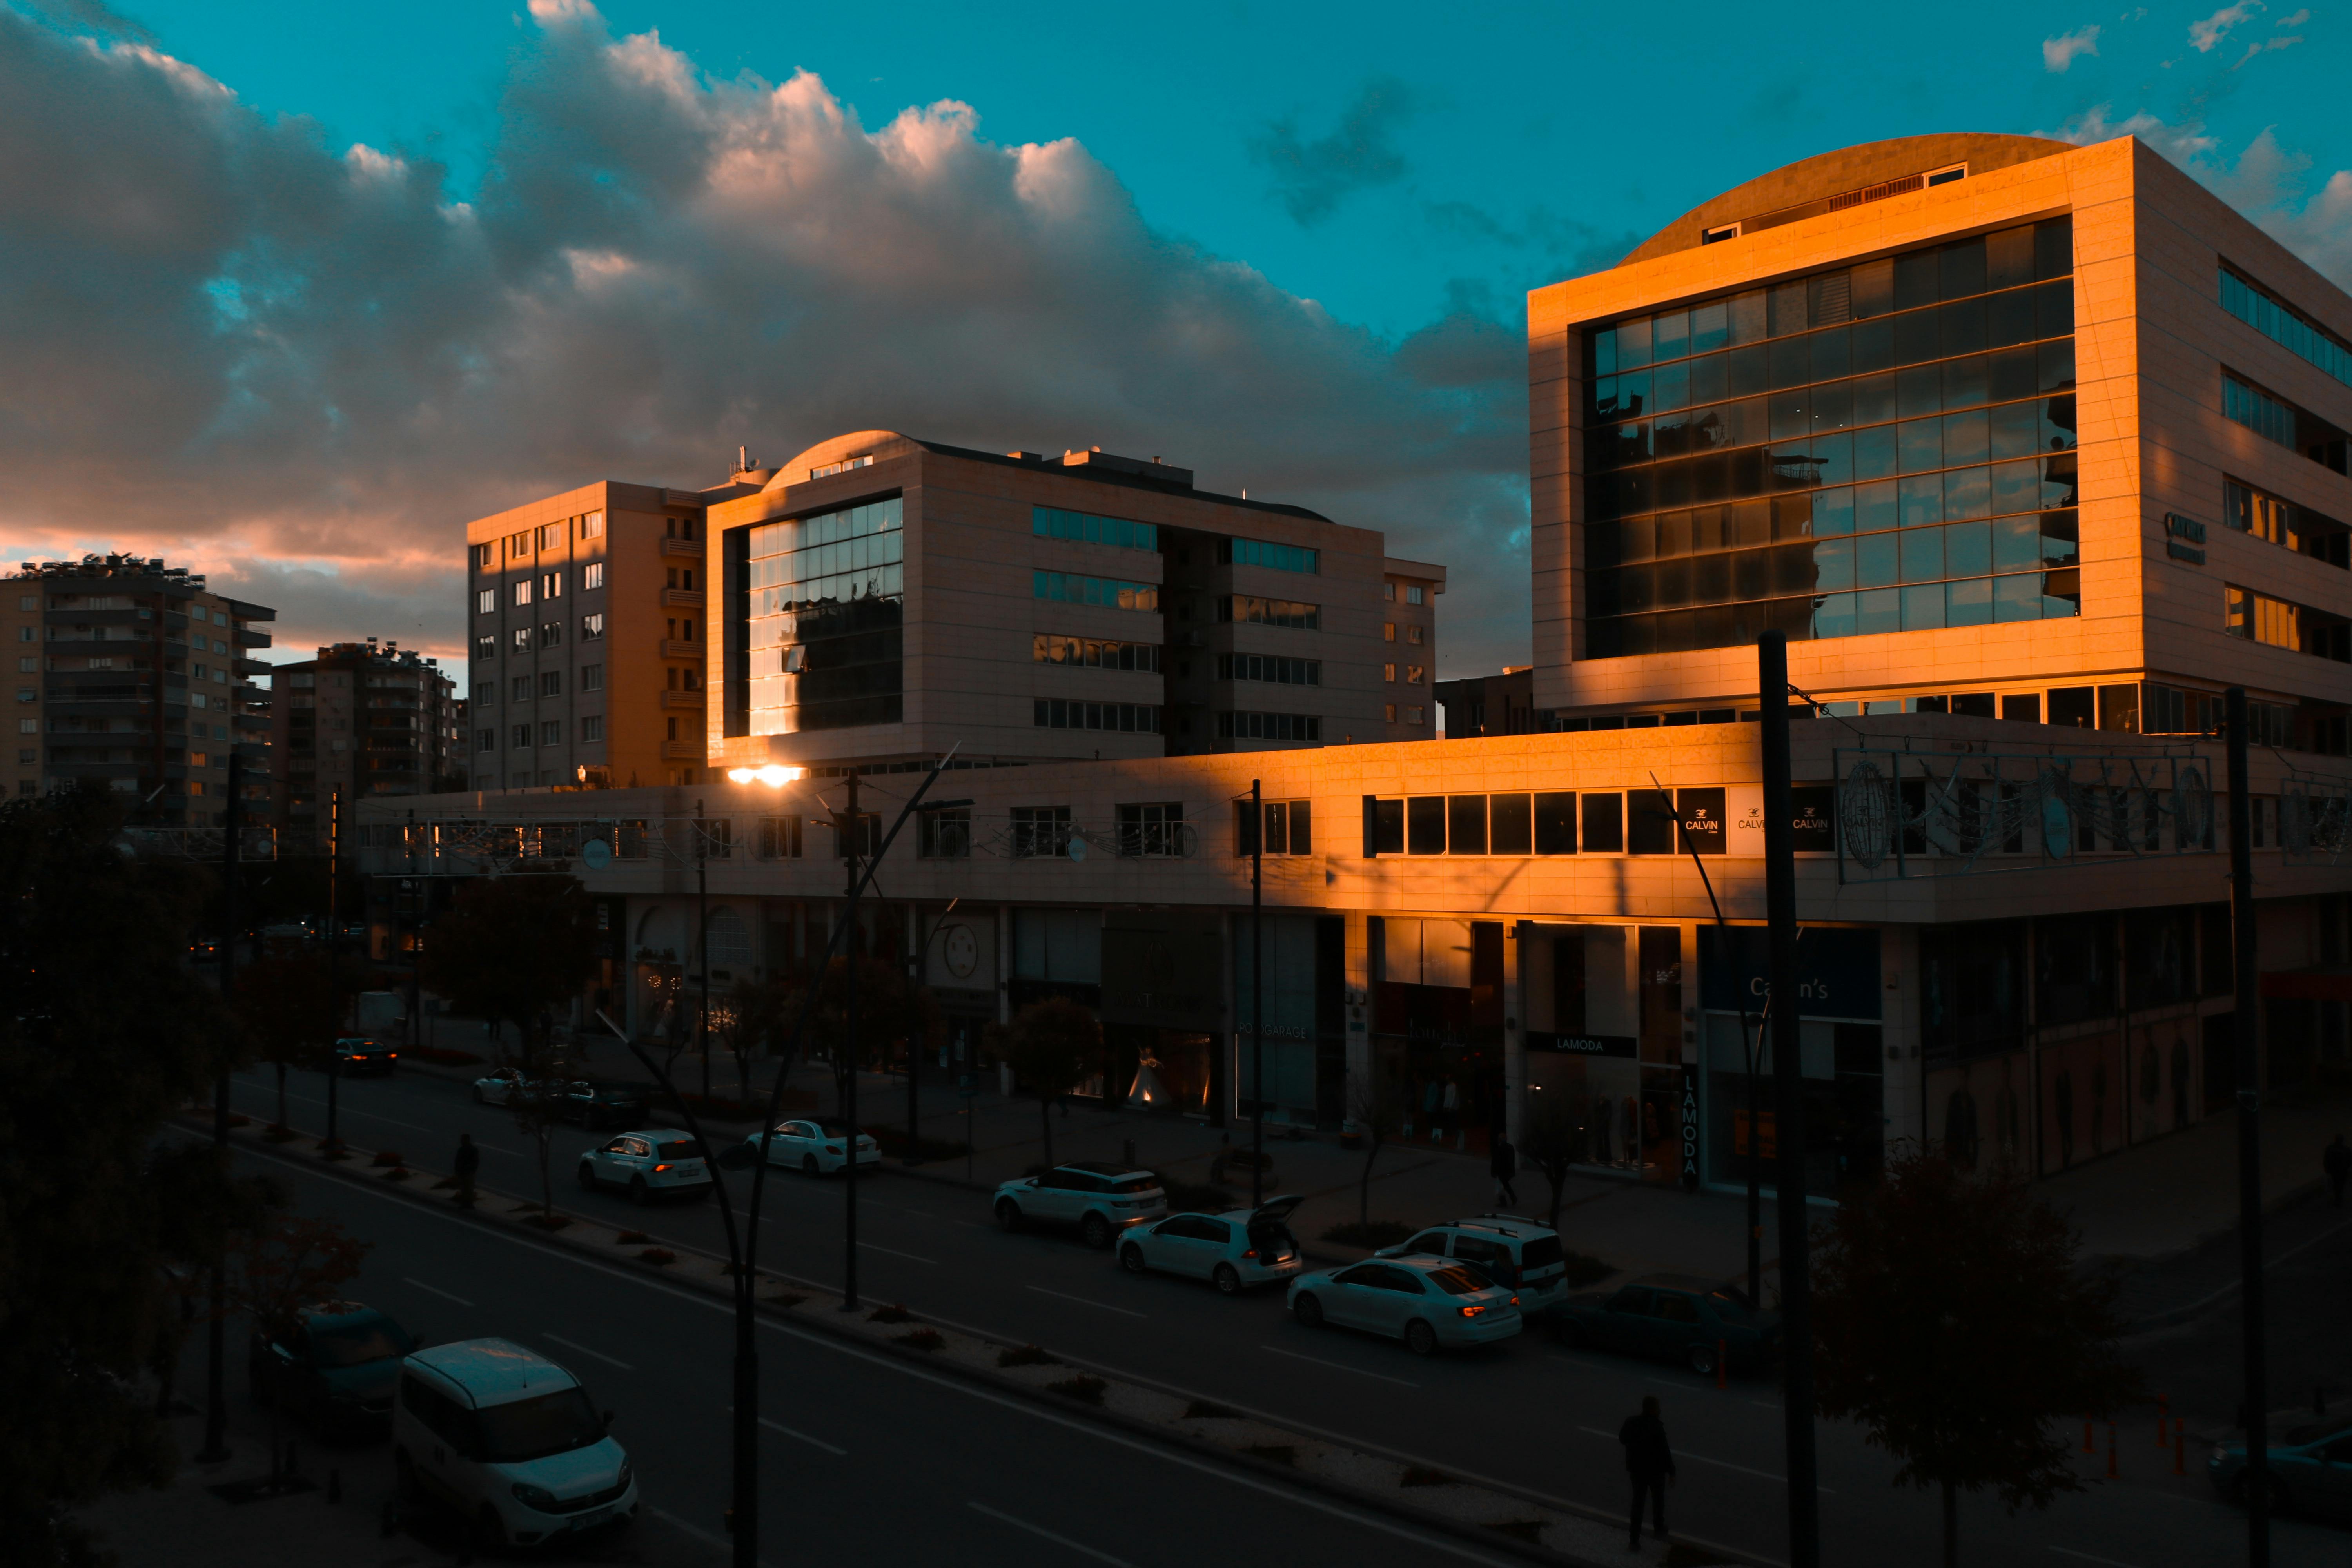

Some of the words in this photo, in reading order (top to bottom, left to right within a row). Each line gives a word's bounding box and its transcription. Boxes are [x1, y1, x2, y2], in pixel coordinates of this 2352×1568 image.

[1750, 976, 1829, 1000] Can's
[1239, 1022, 1306, 1038] POGARAGE
[1557, 1038, 1604, 1051] LAMODA
[1682, 1075, 1697, 1174] LAMODA
